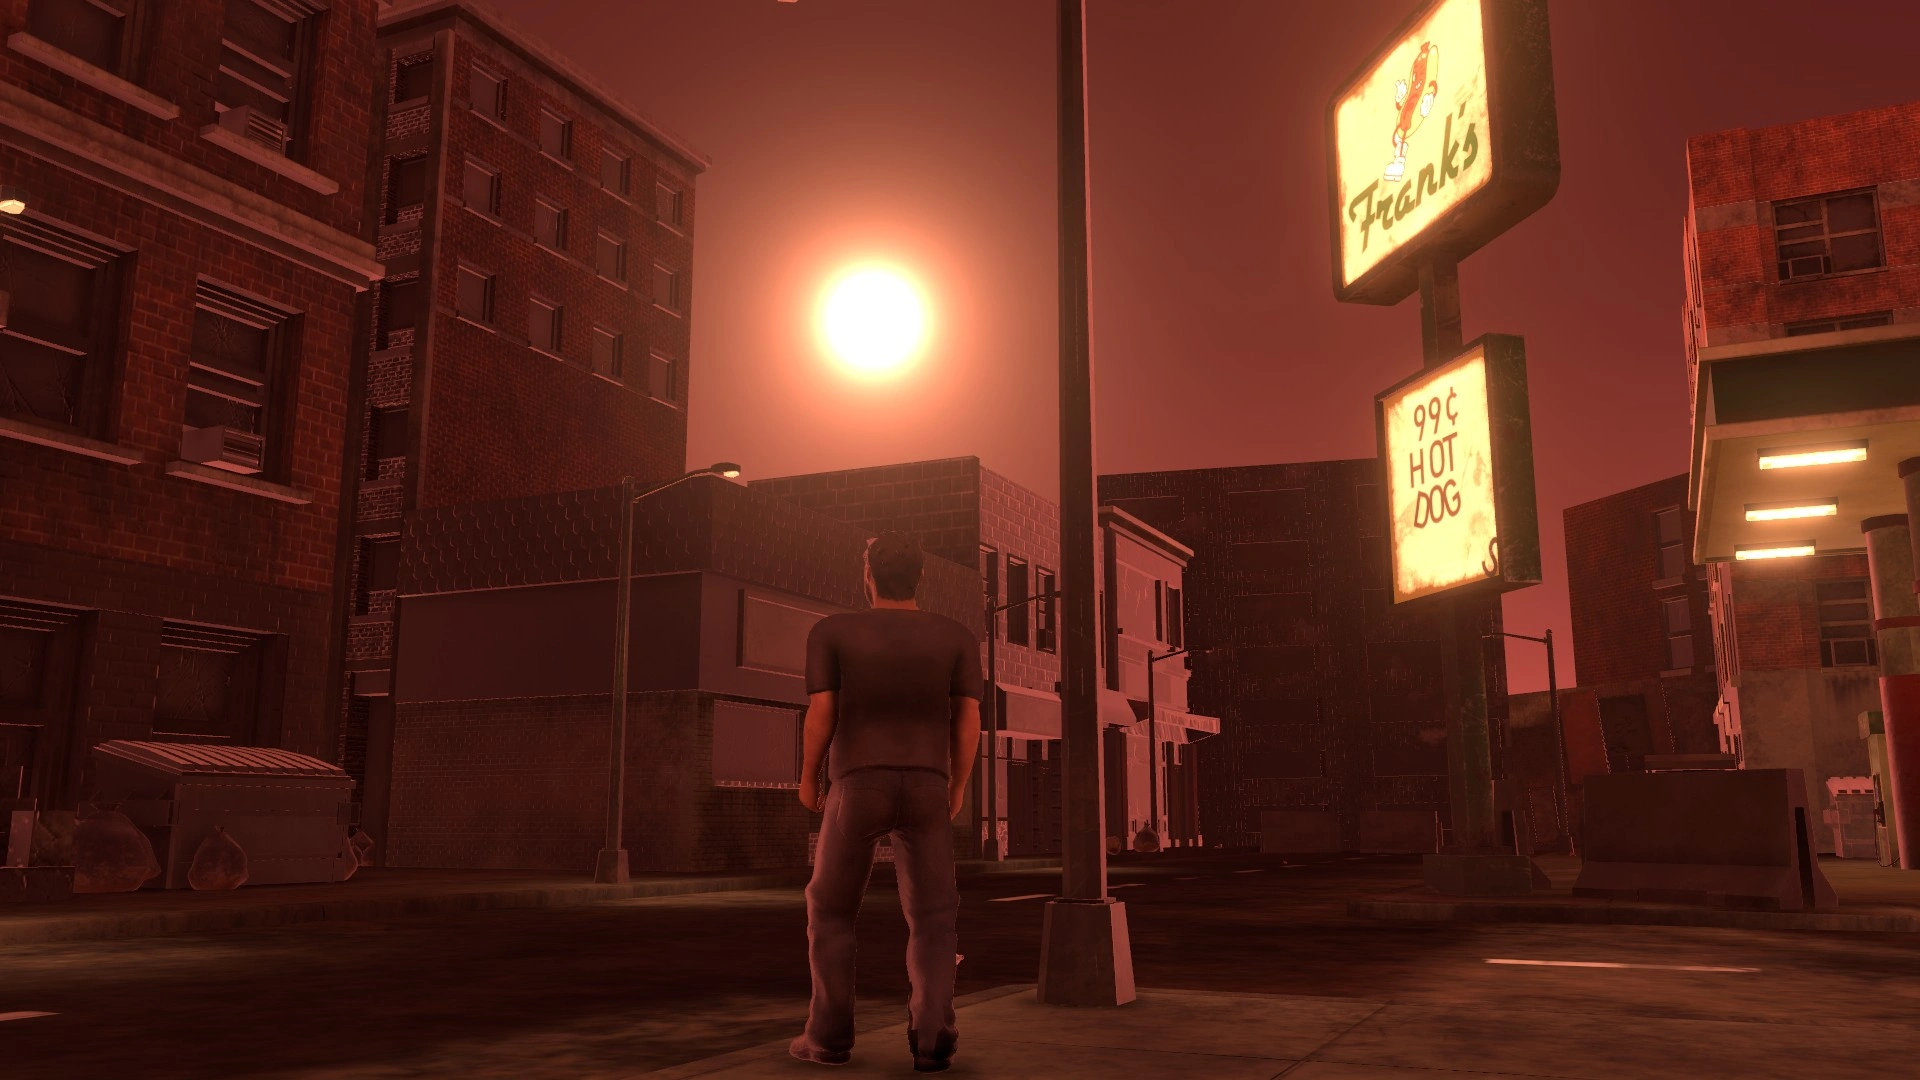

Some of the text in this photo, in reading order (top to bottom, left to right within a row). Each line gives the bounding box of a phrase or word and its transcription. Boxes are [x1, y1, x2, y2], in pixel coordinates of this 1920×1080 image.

[1349, 101, 1479, 254] Frank's
[1413, 386, 1459, 442] 99¢
[1409, 431, 1458, 488] HOT
[1413, 479, 1462, 529] DOG
